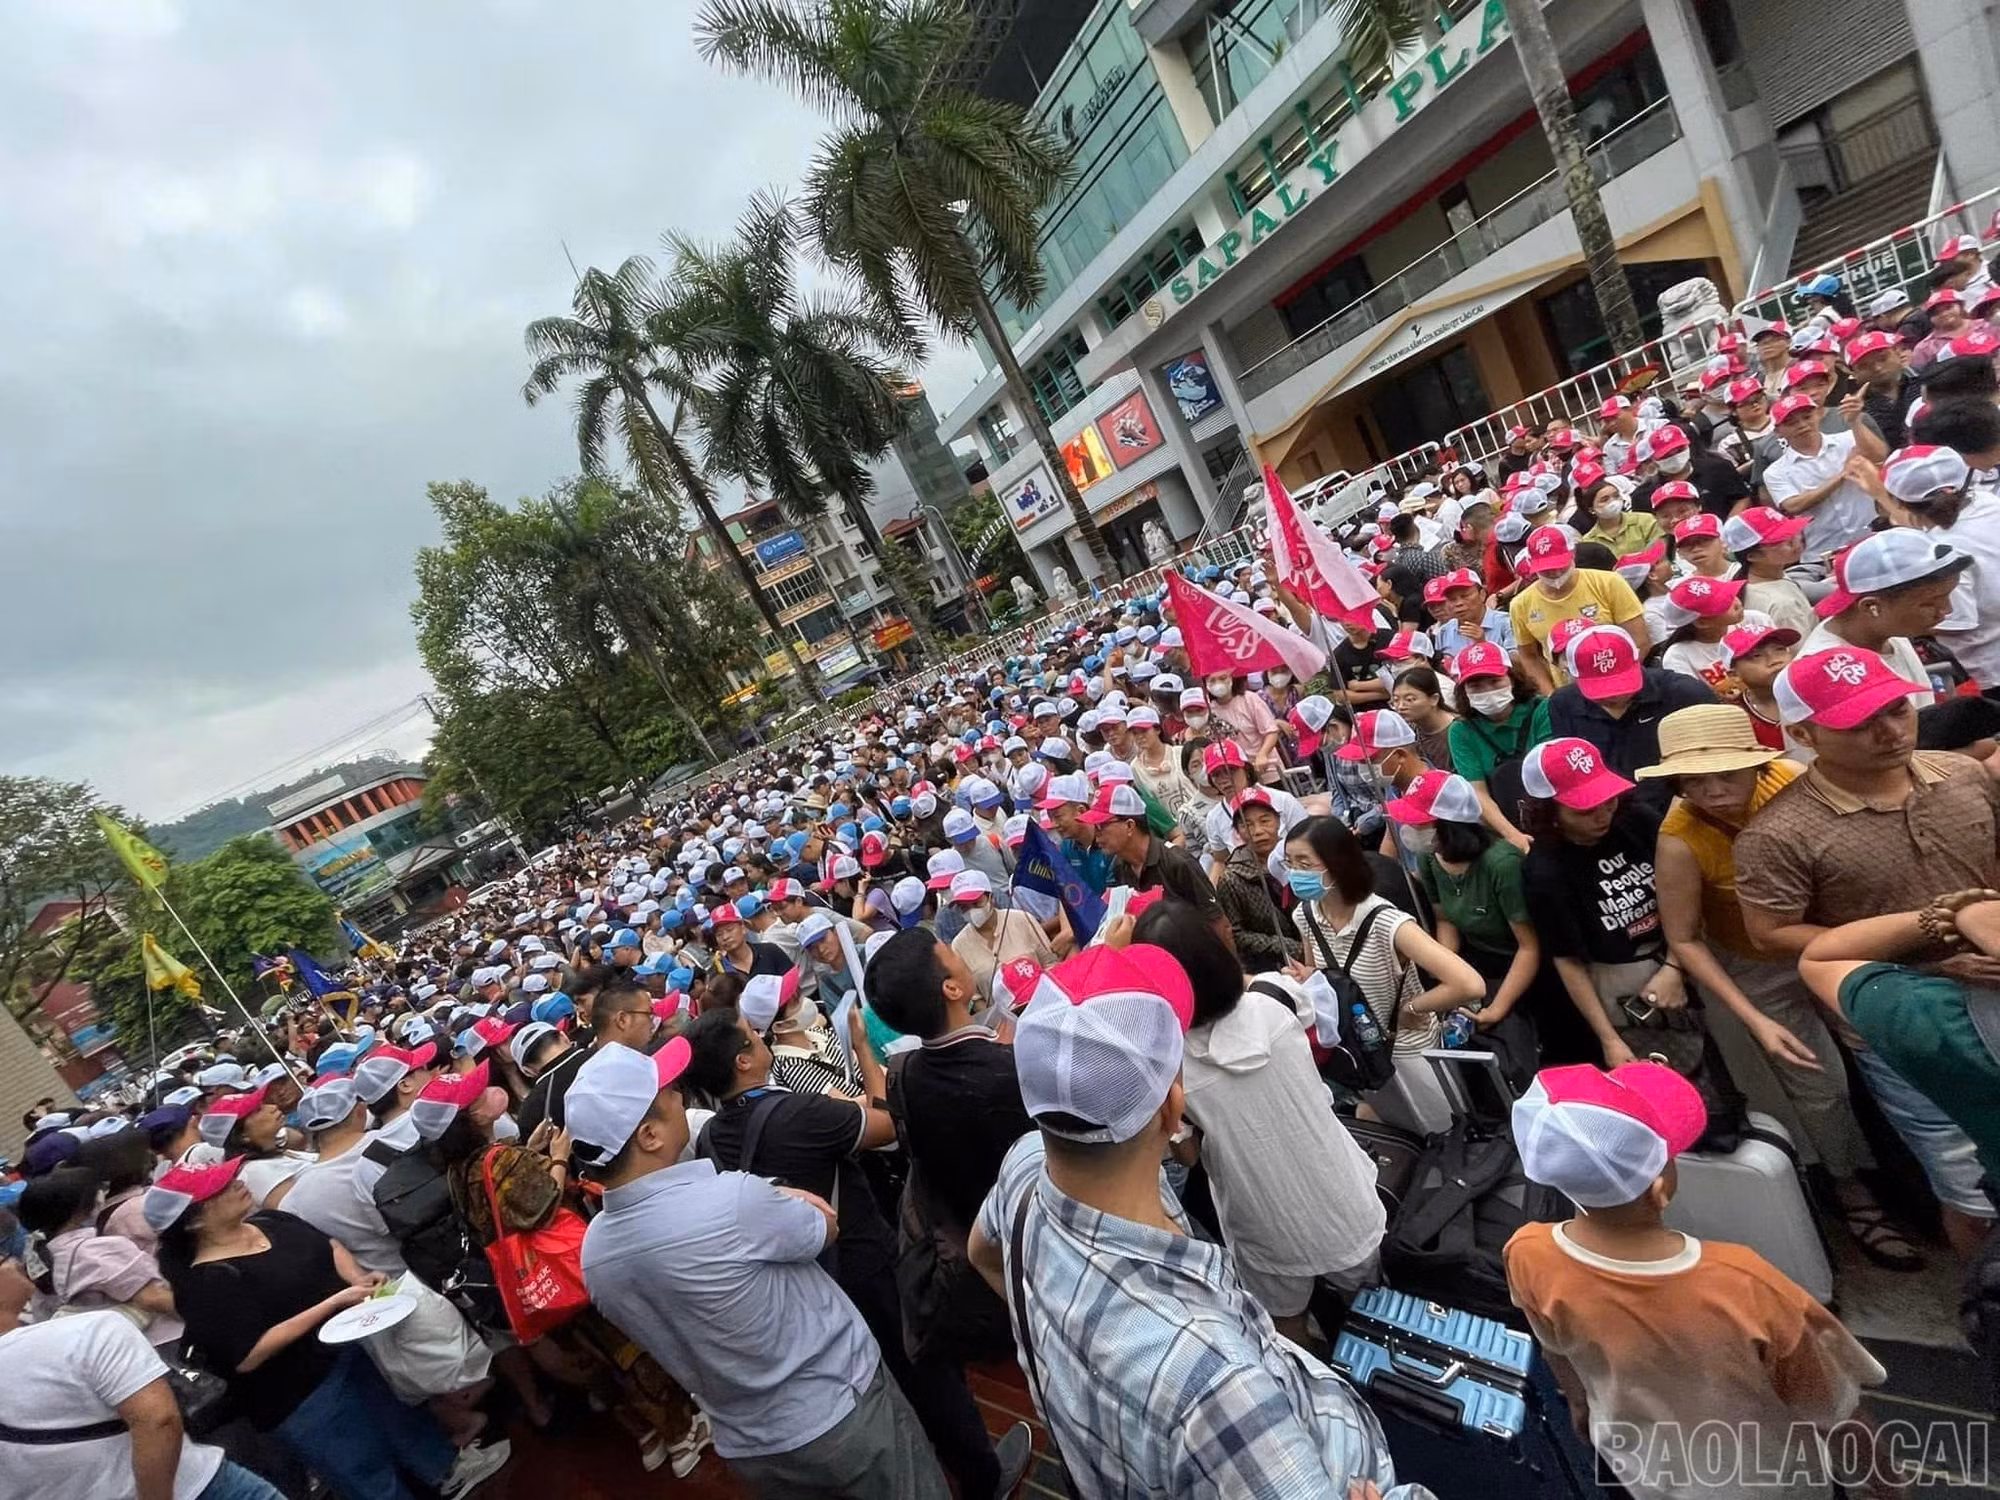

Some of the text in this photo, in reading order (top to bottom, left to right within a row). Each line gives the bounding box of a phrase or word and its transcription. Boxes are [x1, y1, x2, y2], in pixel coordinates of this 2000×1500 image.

[1170, 0, 1509, 305] SAPALY PLA
[1598, 852, 1628, 875] Our
[1598, 862, 1654, 896] People
[1597, 888, 1647, 915] Make
[1600, 898, 1657, 931] Differe
